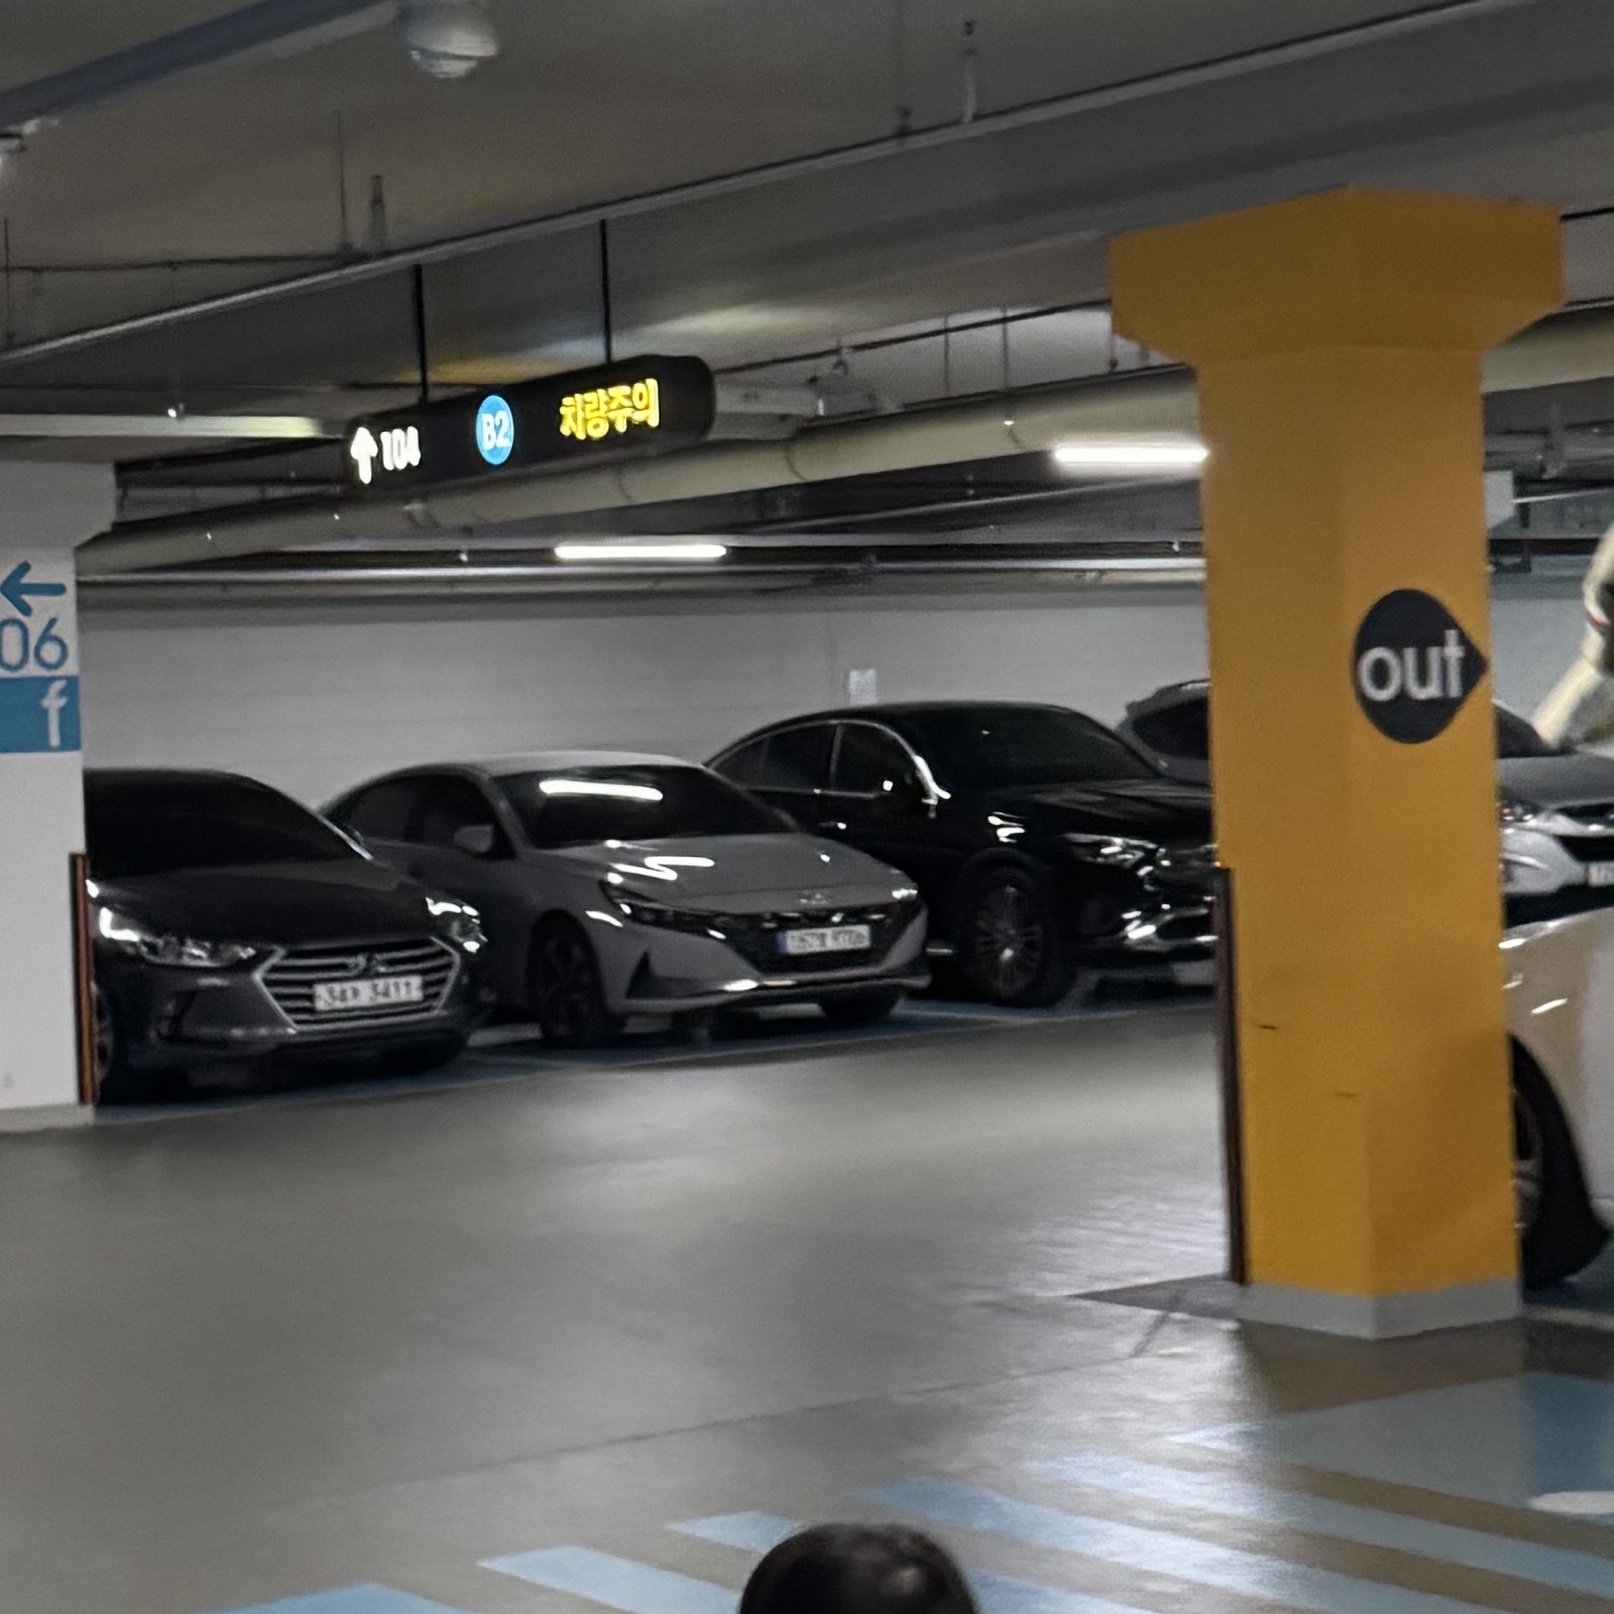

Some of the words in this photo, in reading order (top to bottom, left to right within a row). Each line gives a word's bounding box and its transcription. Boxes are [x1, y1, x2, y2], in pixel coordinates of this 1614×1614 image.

[380, 425, 421, 471] 104
[482, 409, 511, 451] B2
[558, 378, 660, 440] 차량주의
[1357, 628, 1467, 702] out
[39, 678, 68, 748] f
